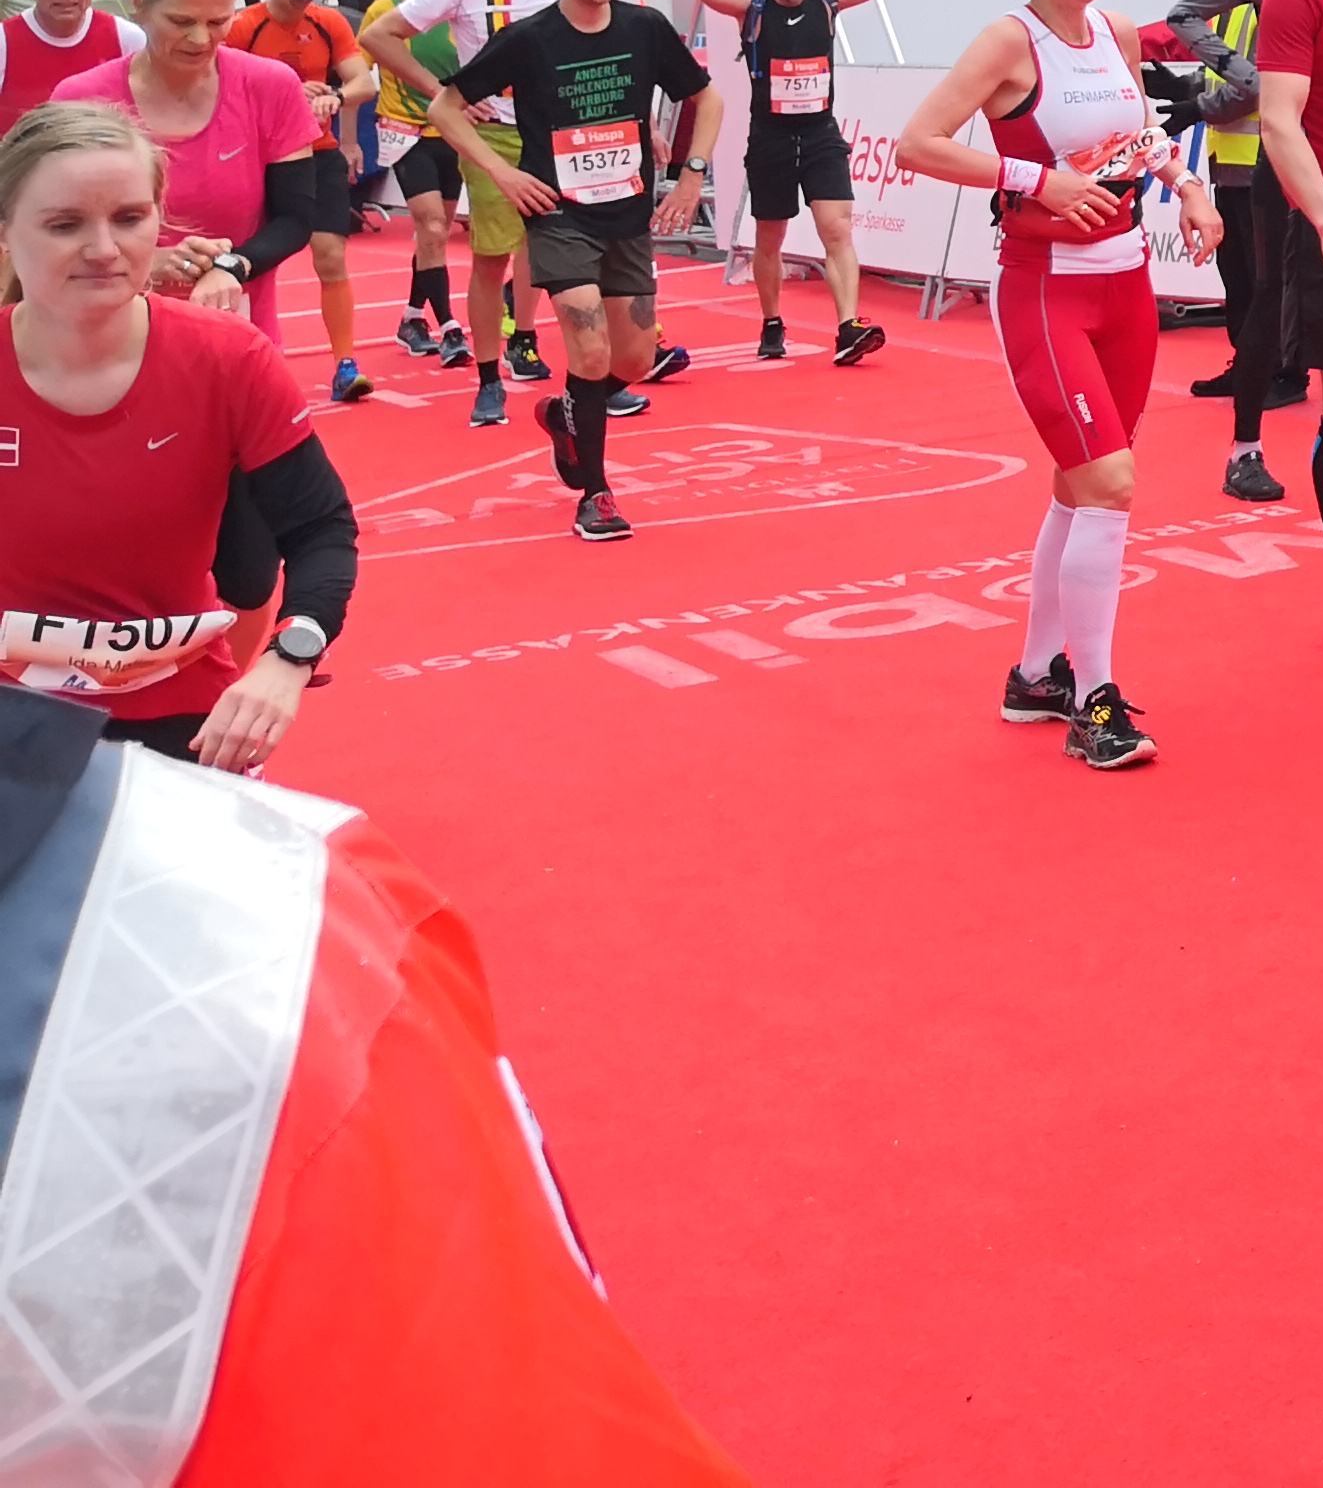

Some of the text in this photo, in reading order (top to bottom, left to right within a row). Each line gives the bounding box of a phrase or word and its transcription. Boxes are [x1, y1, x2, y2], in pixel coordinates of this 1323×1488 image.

[574, 63, 618, 82] ANDERE
[783, 77, 818, 91] 7571
[570, 89, 625, 110] HARBURG
[1064, 90, 1121, 105] DENMARK
[588, 128, 625, 144] Haspa
[569, 148, 631, 173] 15372
